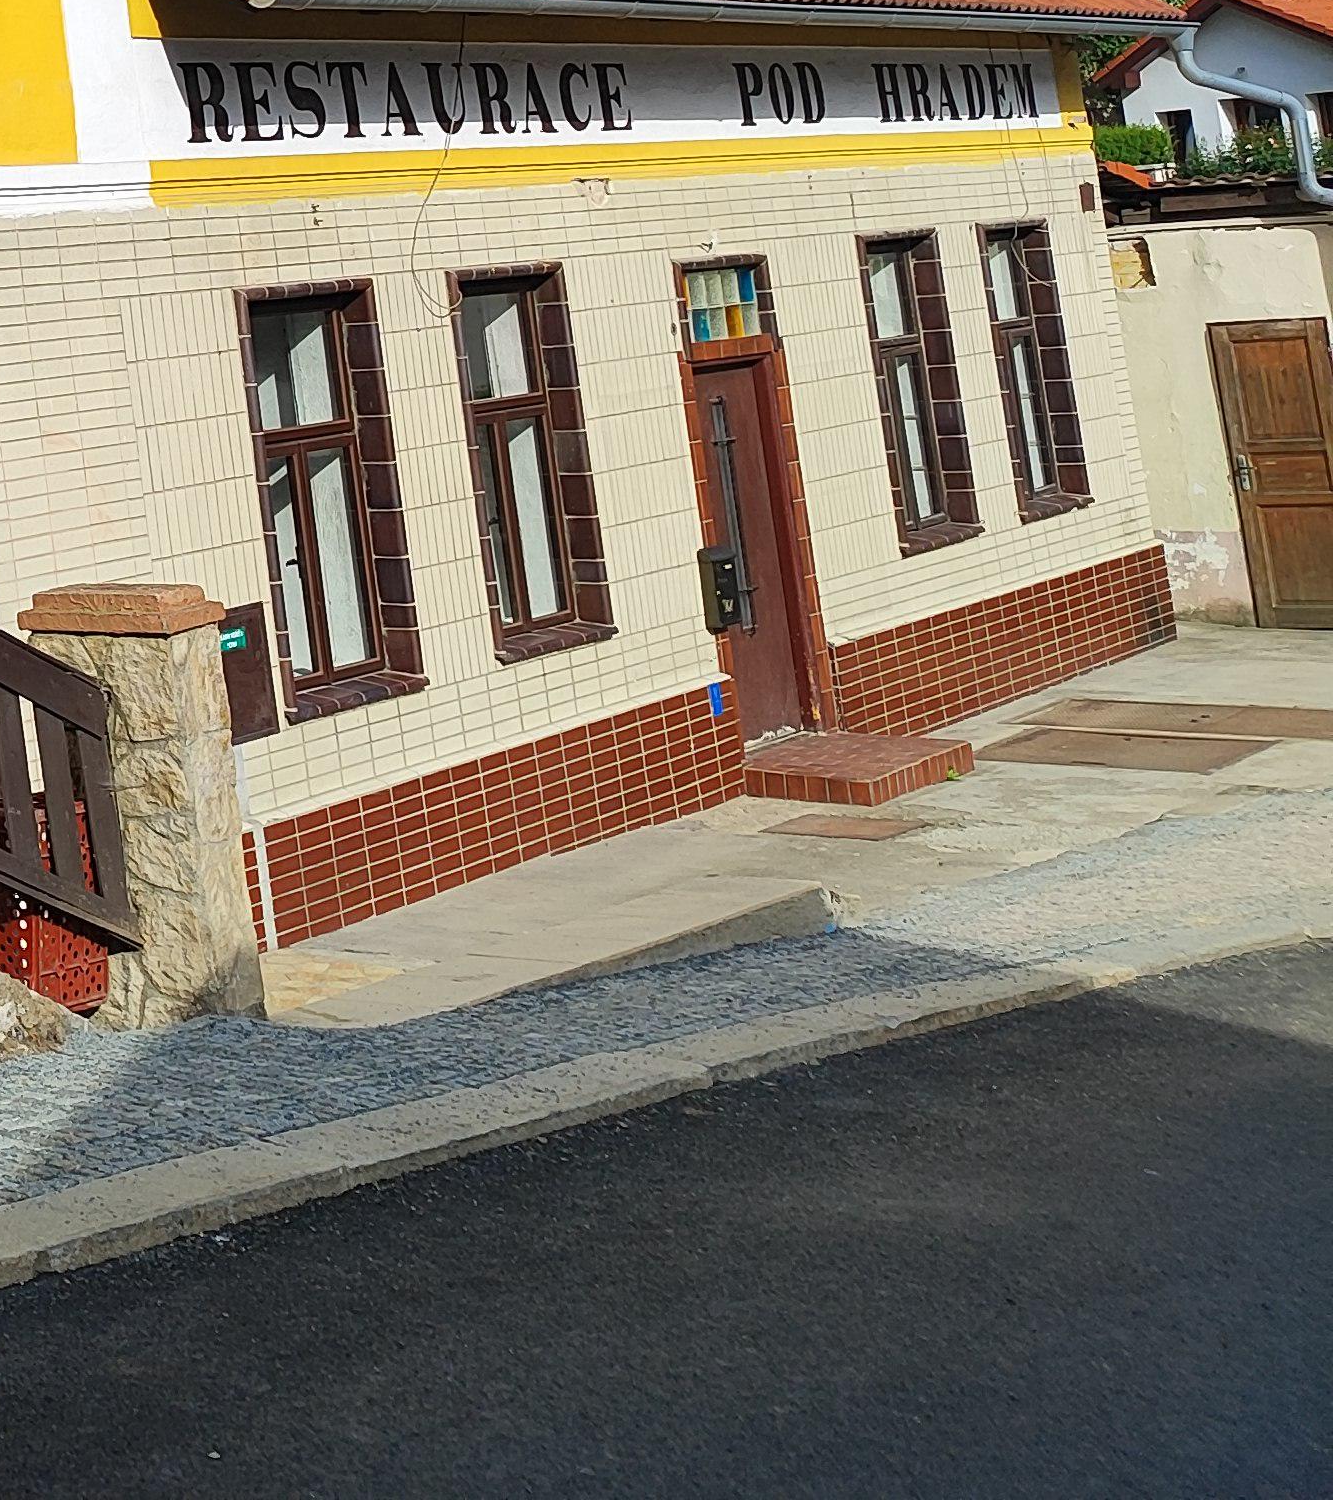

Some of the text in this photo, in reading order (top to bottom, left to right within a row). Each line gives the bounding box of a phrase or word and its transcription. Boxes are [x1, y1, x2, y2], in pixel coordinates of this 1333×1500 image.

[177, 61, 1040, 143] RESTAURACE POD HRADEM
